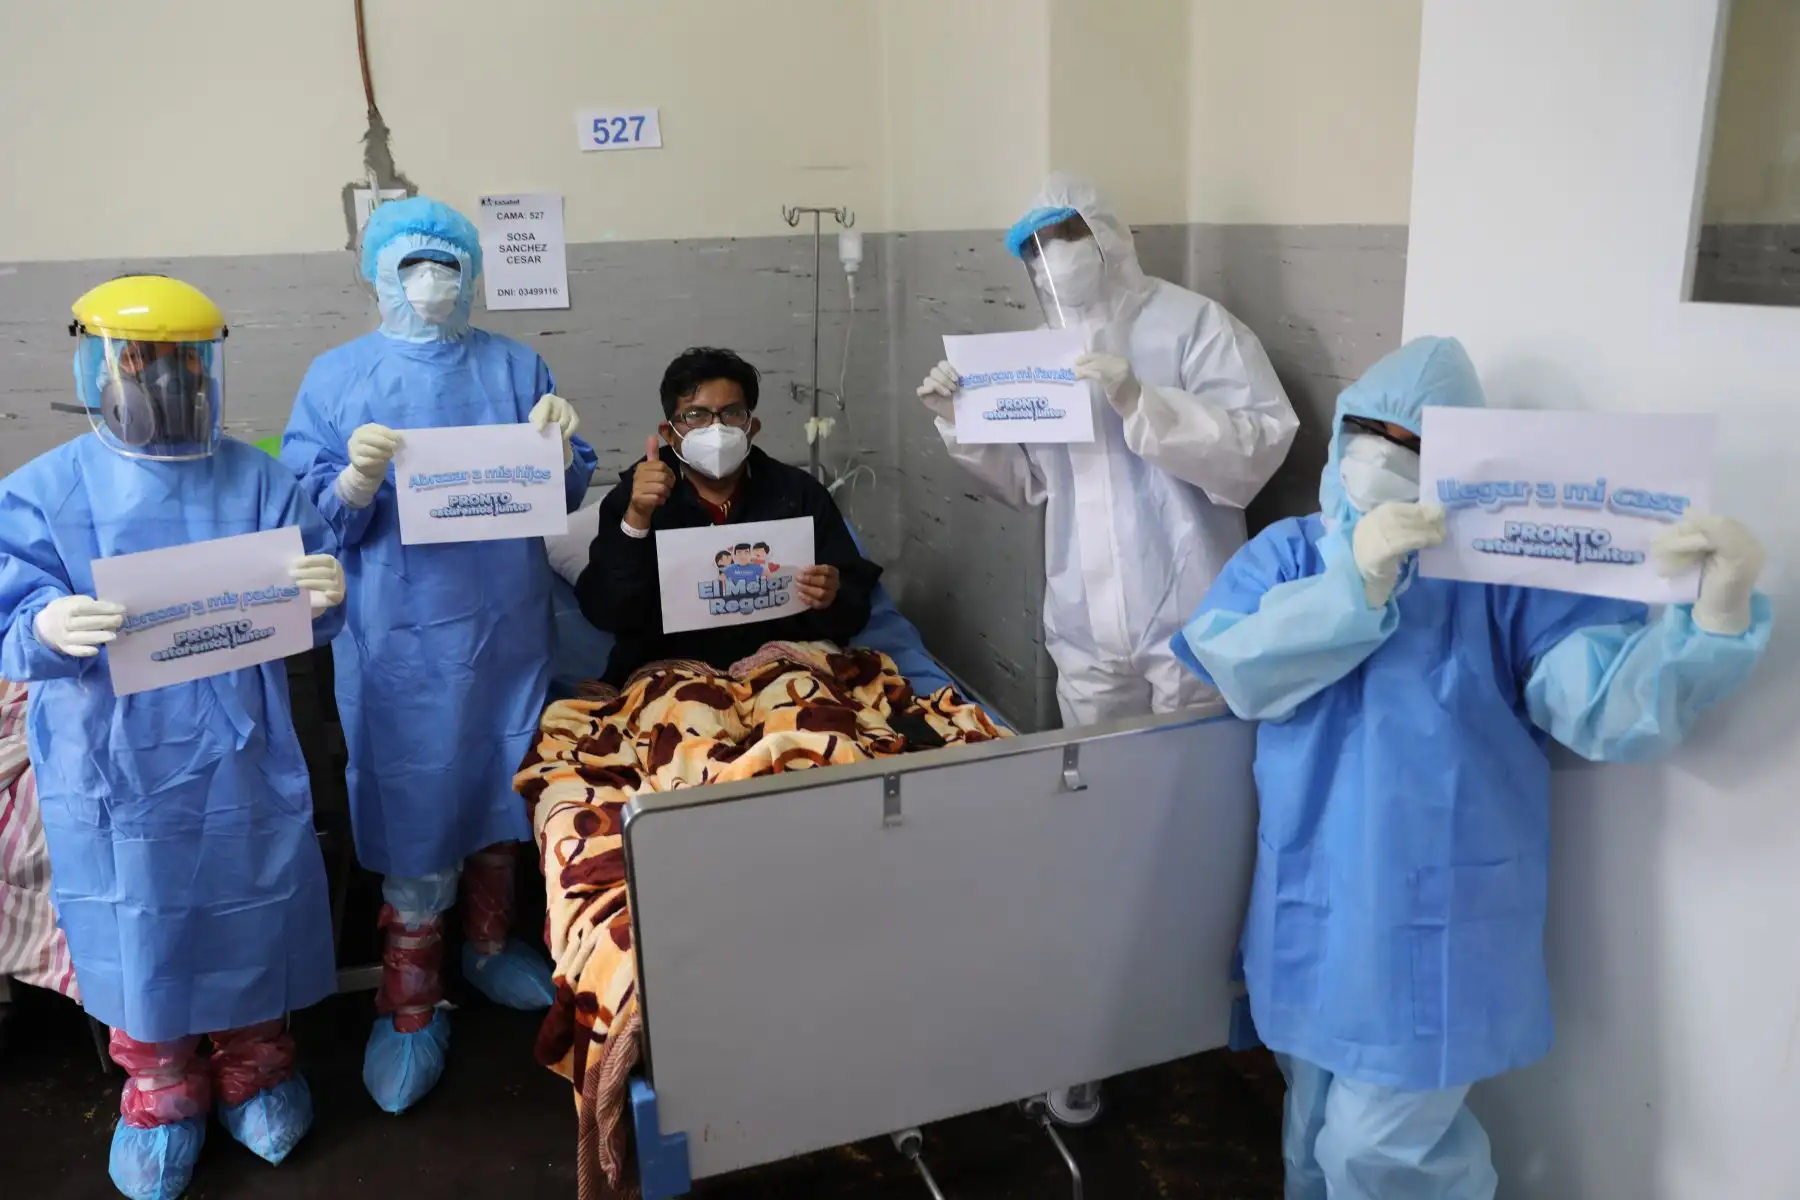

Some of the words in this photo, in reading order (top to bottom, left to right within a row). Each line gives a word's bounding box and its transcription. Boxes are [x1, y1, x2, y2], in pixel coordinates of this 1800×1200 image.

[593, 116, 645, 144] 527
[529, 211, 545, 220] 527
[506, 232, 536, 242] SOSA
[499, 243, 547, 254] SANCHEZ
[506, 255, 542, 264] CESAR
[497, 286, 516, 297] DNI:
[518, 287, 558, 296] 03499116
[992, 370, 1014, 383] con
[1015, 367, 1032, 382] mi
[997, 397, 1049, 411] PRONTO
[982, 410, 1033, 420] estaremos
[1034, 409, 1066, 421] juntos
[409, 471, 469, 490] Abrazar
[472, 470, 482, 482] a
[485, 467, 512, 482] mis
[514, 465, 551, 485] hijos
[448, 492, 512, 507] PRONTO
[1534, 481, 1556, 506] a
[1561, 478, 1607, 508] mi
[1609, 486, 1690, 521] casa
[430, 505, 493, 518] estaremos
[493, 503, 532, 517] juntos
[1504, 520, 1612, 547] PRONTO
[1471, 537, 1577, 561] estaremos
[1573, 544, 1646, 565] juntos
[697, 579, 723, 600] El
[725, 575, 792, 598] Mejor
[190, 601, 204, 614] a
[208, 592, 238, 612] mis
[240, 585, 300, 611] padres
[709, 591, 790, 615] Regalo
[173, 619, 252, 646] PRONTO
[151, 640, 230, 661] estaremos
[229, 627, 275, 649] juntos
